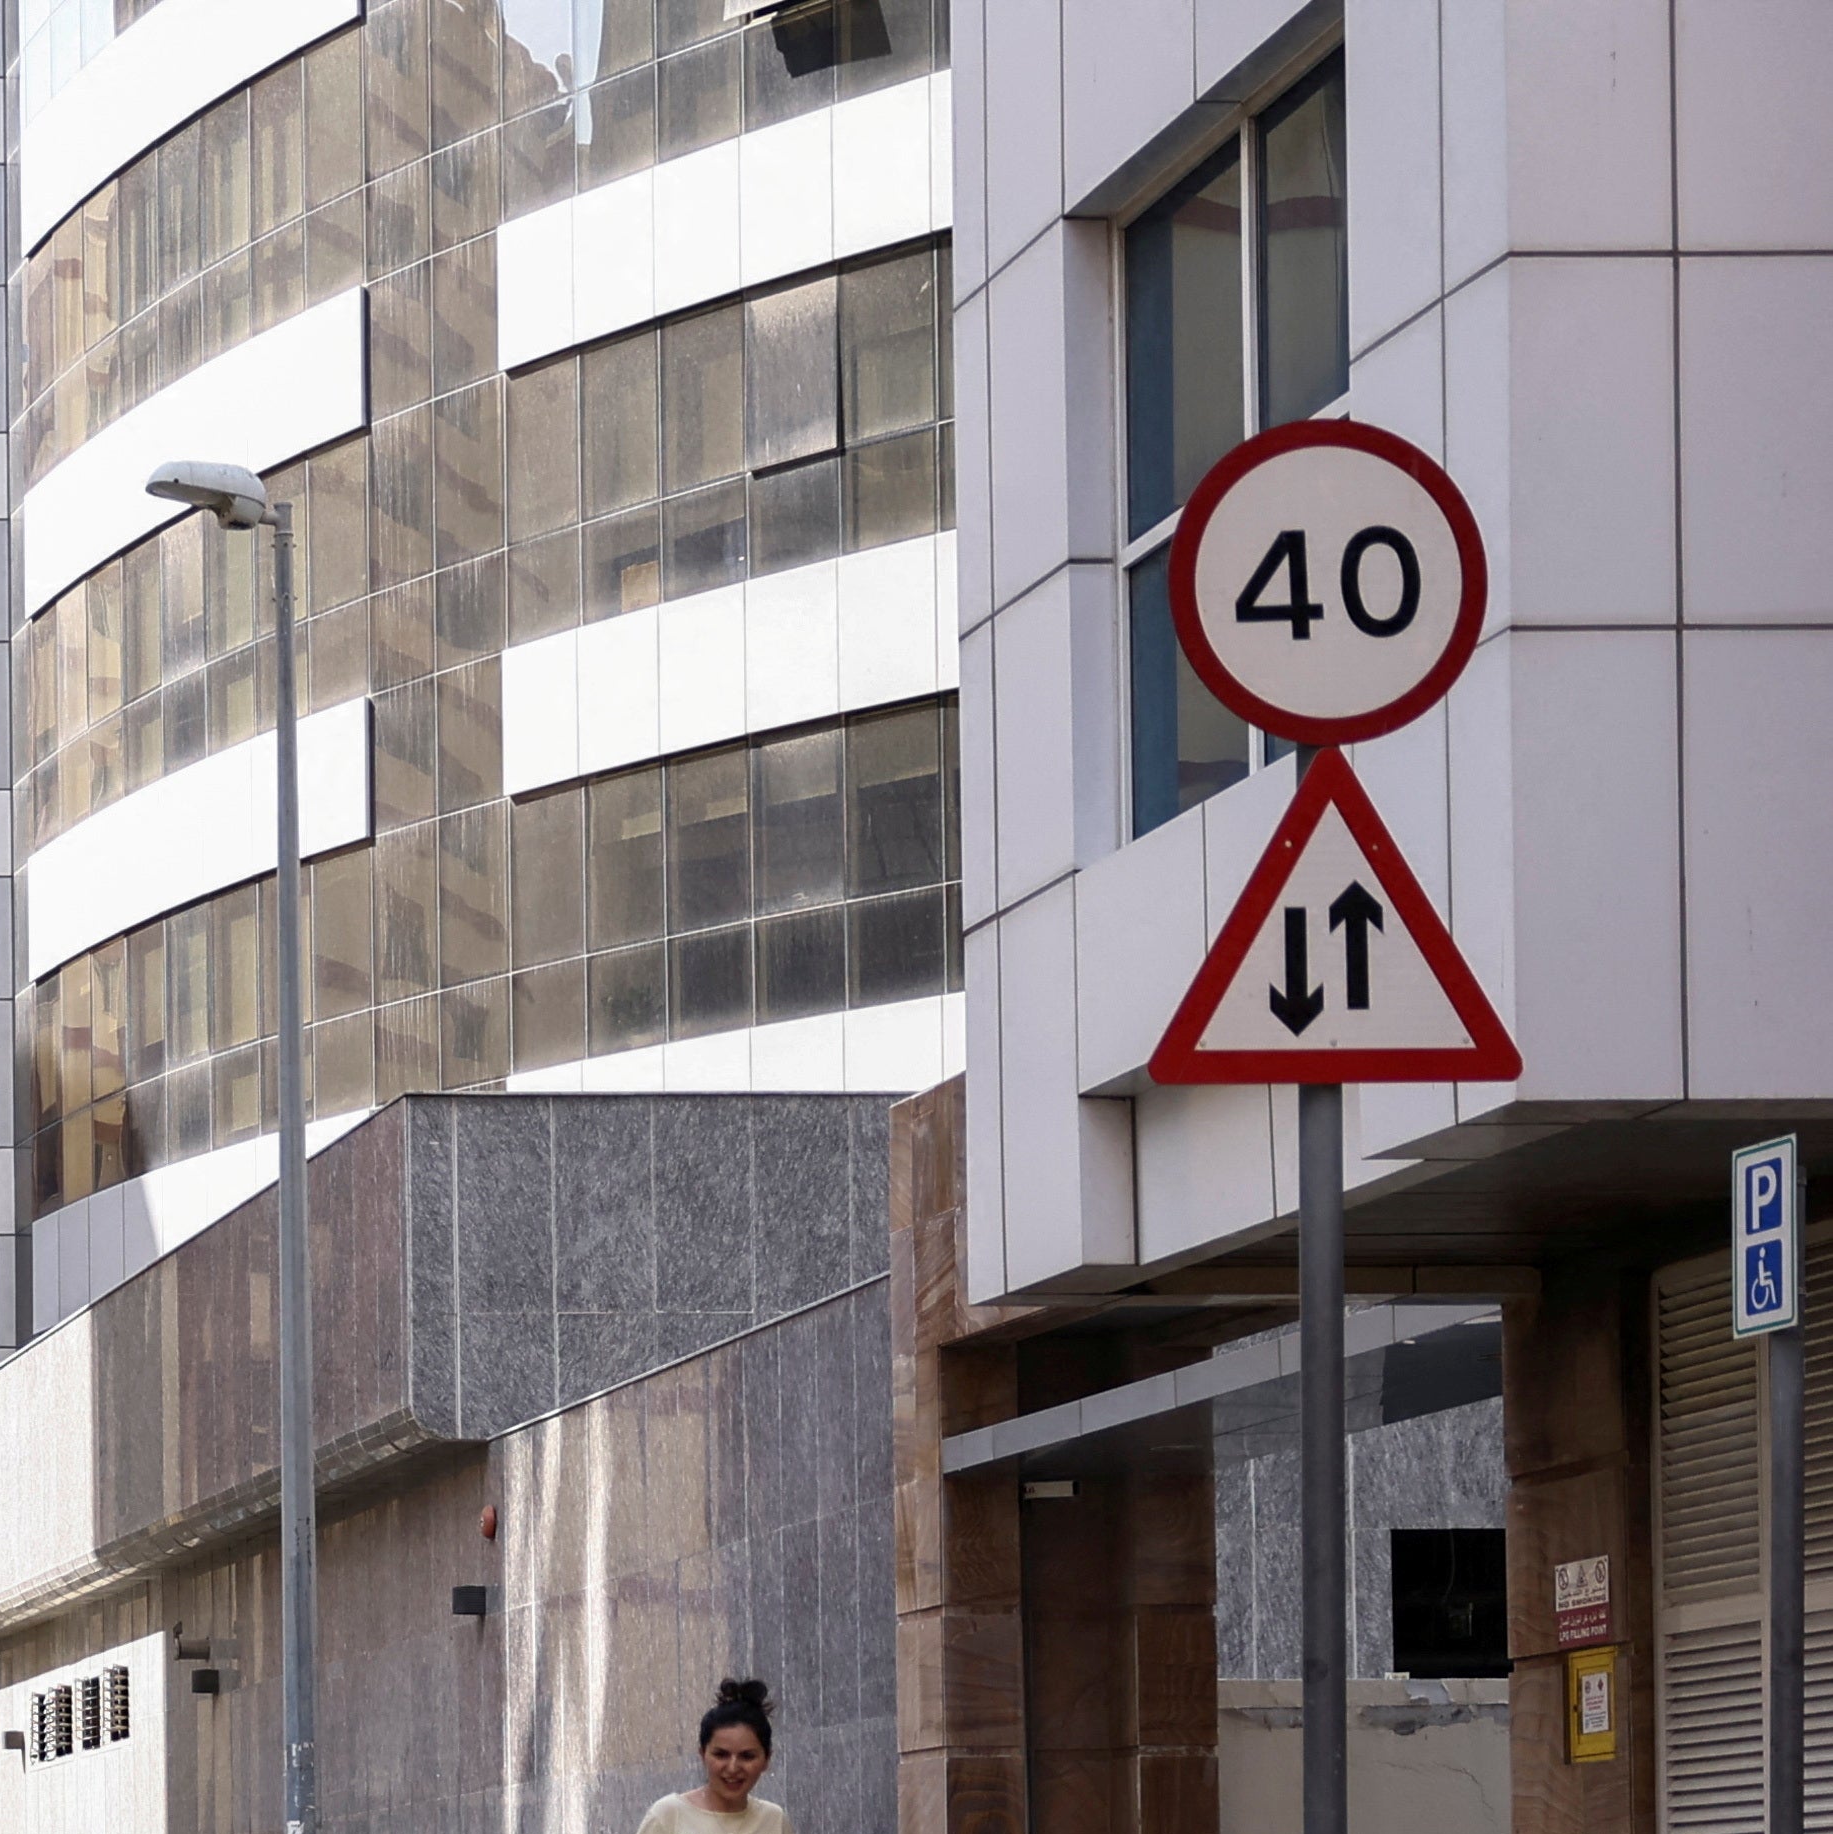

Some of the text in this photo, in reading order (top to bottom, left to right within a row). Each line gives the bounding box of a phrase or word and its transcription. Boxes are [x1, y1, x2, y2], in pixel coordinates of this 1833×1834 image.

[1235, 526, 1422, 641] 40
[1752, 1165, 1777, 1230] P
[1572, 1594, 1606, 1606] SMOKING
[1559, 1624, 1606, 1642] LPG FILLING POINT
